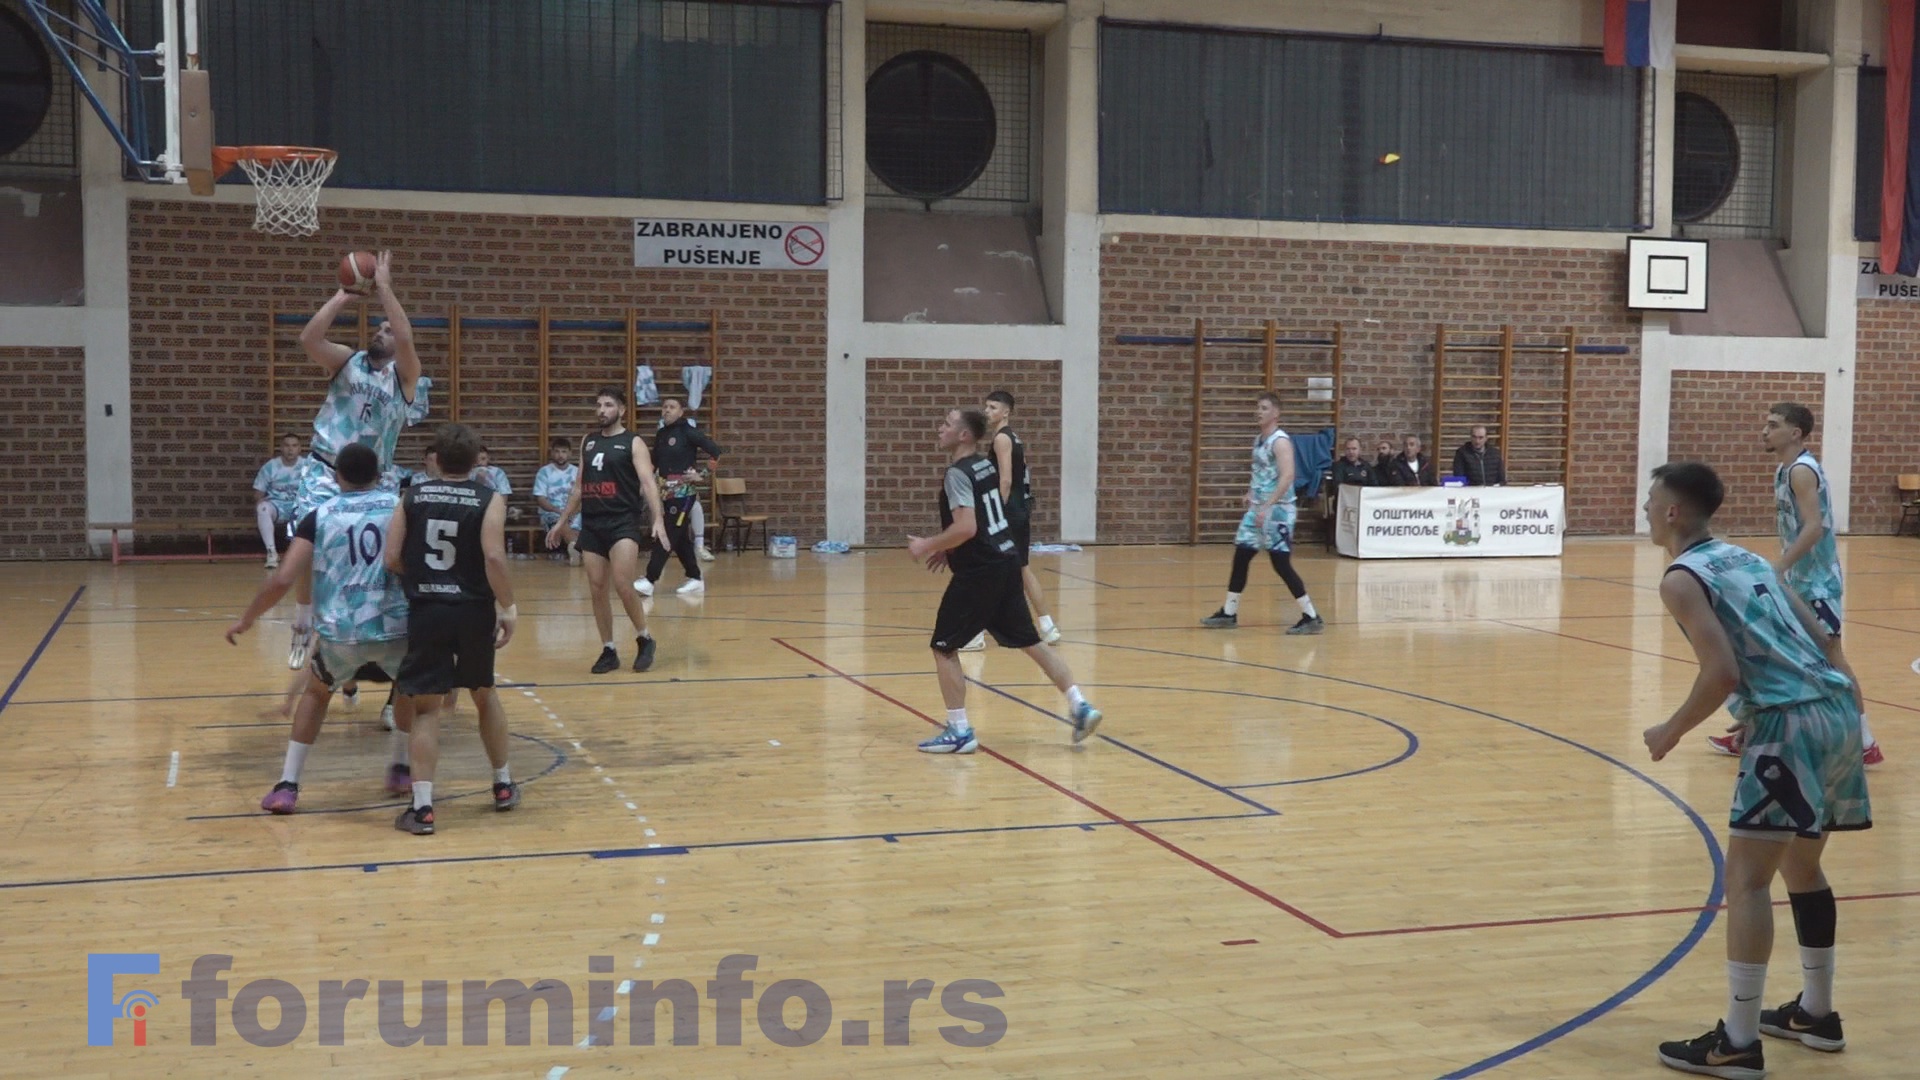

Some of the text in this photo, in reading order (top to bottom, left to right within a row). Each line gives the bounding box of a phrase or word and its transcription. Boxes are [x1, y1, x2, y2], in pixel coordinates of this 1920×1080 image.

[637, 222, 782, 239] ZABRANJENO
[664, 245, 761, 265] PUŠENJE
[1879, 280, 1920, 297] PUŠE
[591, 452, 605, 471] 4
[982, 487, 1009, 536] 11
[1373, 509, 1434, 520] ОПШТИНА
[1500, 508, 1549, 520] OPŠTINA
[1367, 525, 1439, 537] ПРИЈЕПОЉЕ
[1492, 524, 1555, 536] PRIJEPOLJE
[347, 522, 382, 567] 10
[425, 518, 459, 571] 5
